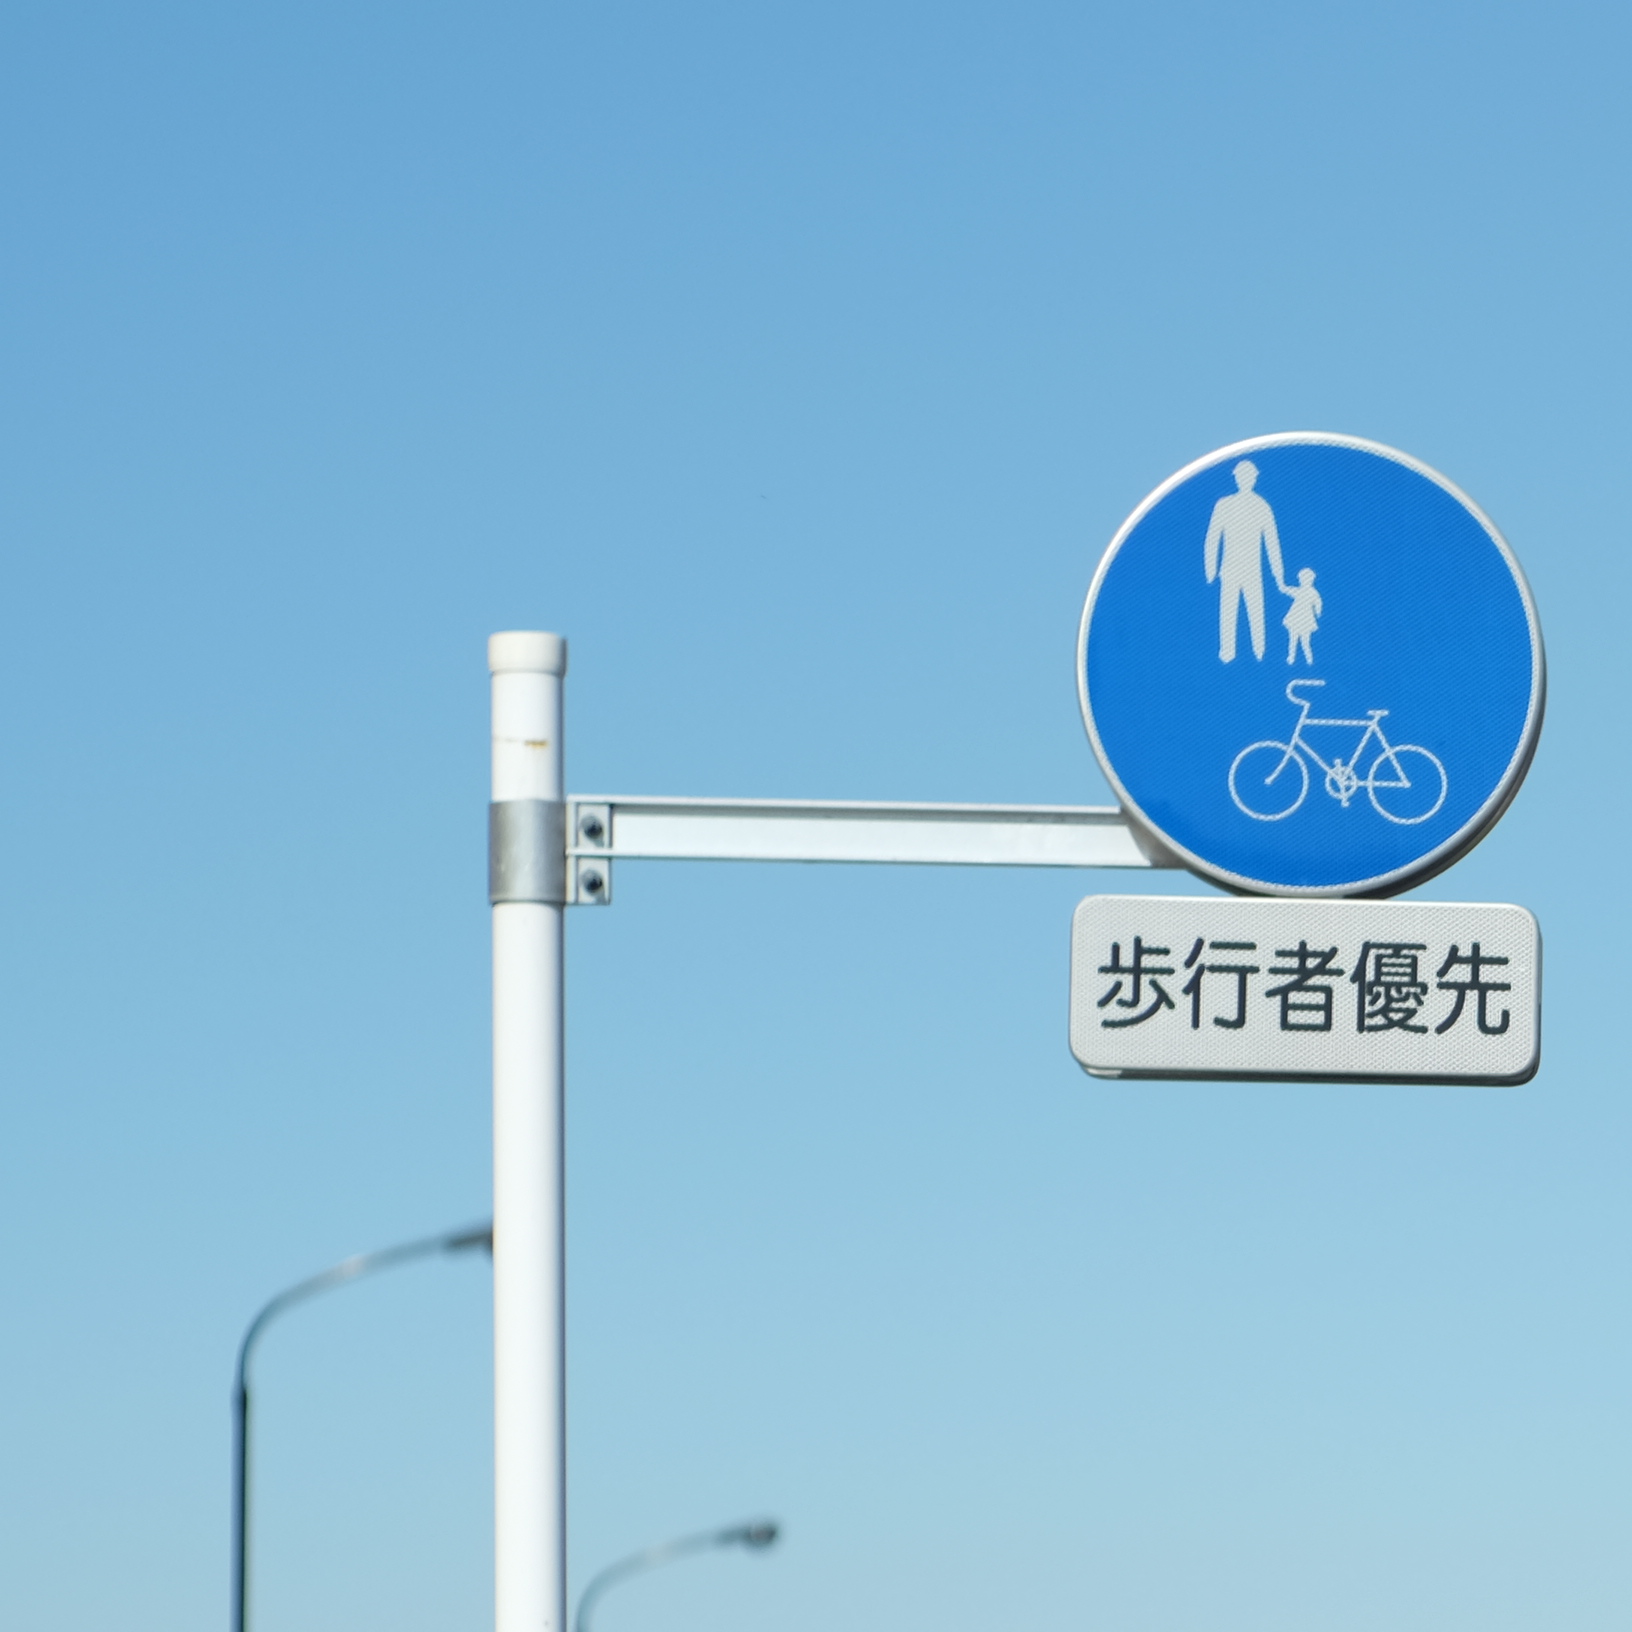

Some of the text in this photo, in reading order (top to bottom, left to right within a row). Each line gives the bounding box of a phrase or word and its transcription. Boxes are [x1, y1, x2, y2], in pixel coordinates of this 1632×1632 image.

[1097, 935, 1512, 1036] 歩行者優先
